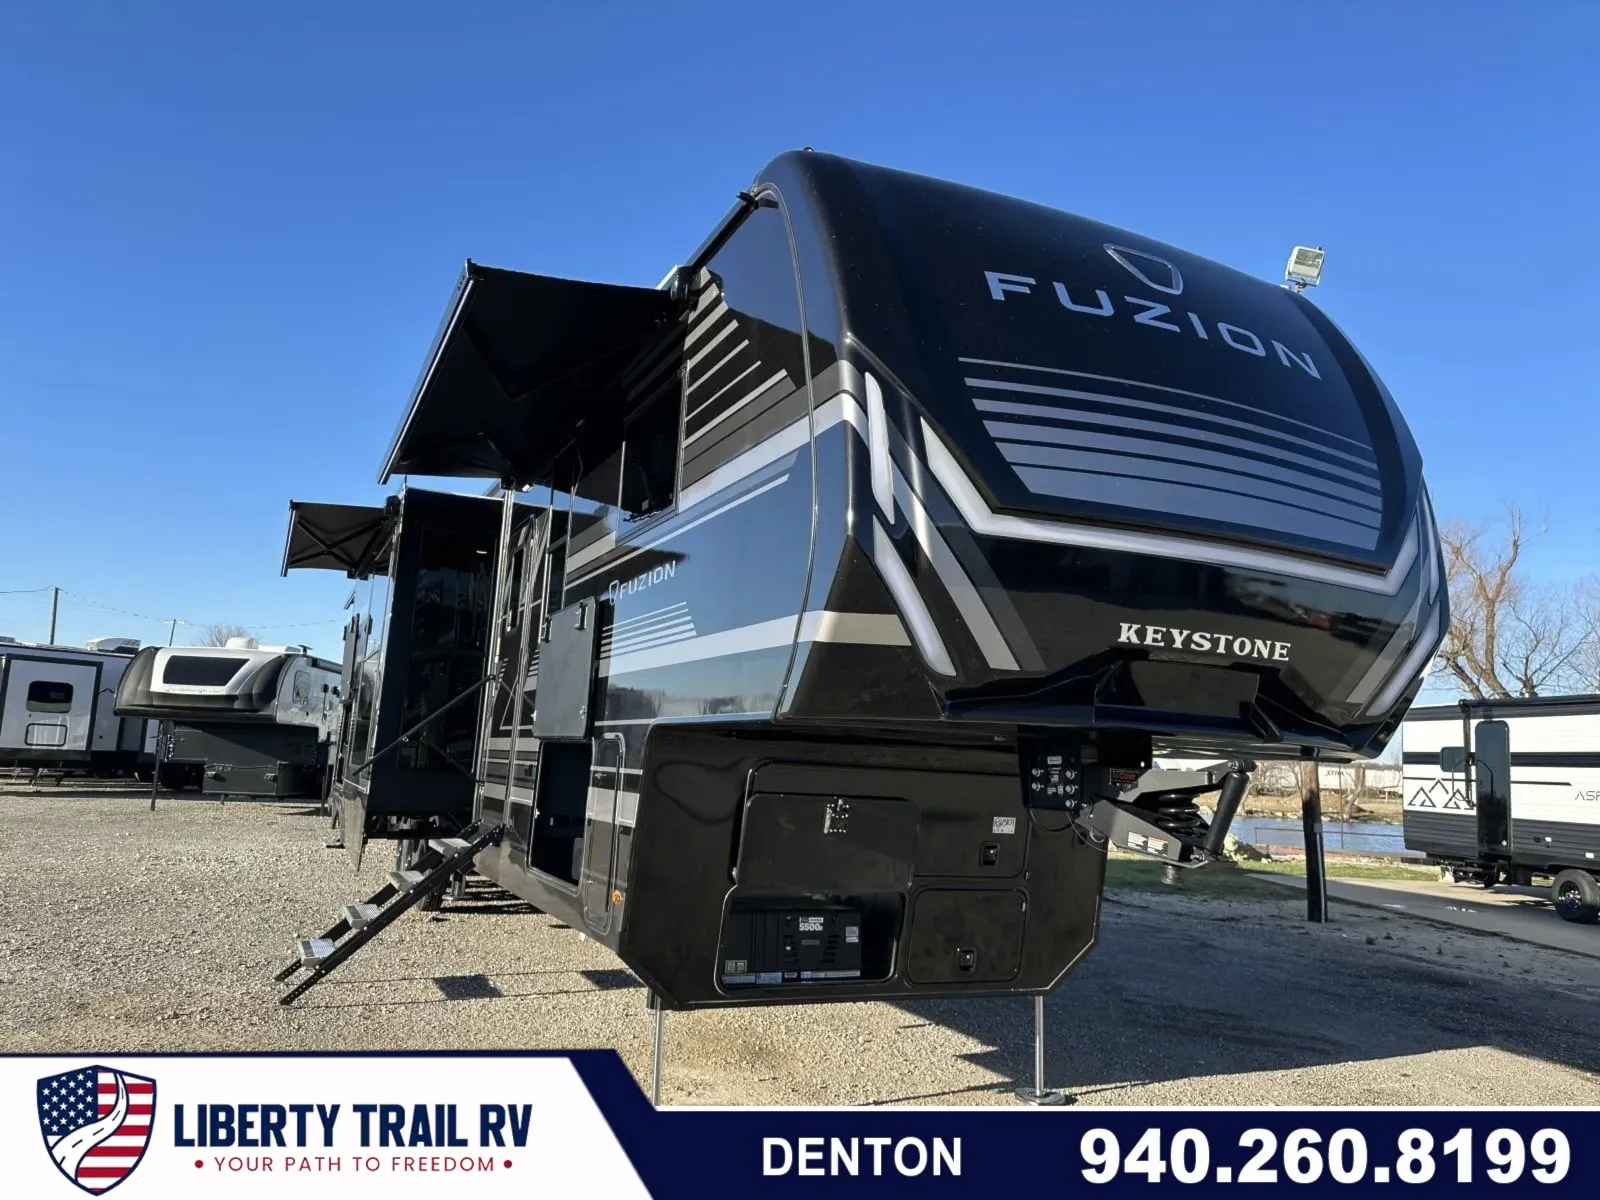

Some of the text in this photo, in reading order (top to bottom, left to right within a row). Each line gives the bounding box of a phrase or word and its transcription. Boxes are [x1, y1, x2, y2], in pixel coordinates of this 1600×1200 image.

[984, 270, 1322, 381] FUZION
[619, 560, 676, 600] FUZION
[1117, 622, 1292, 662] KEYSTONE
